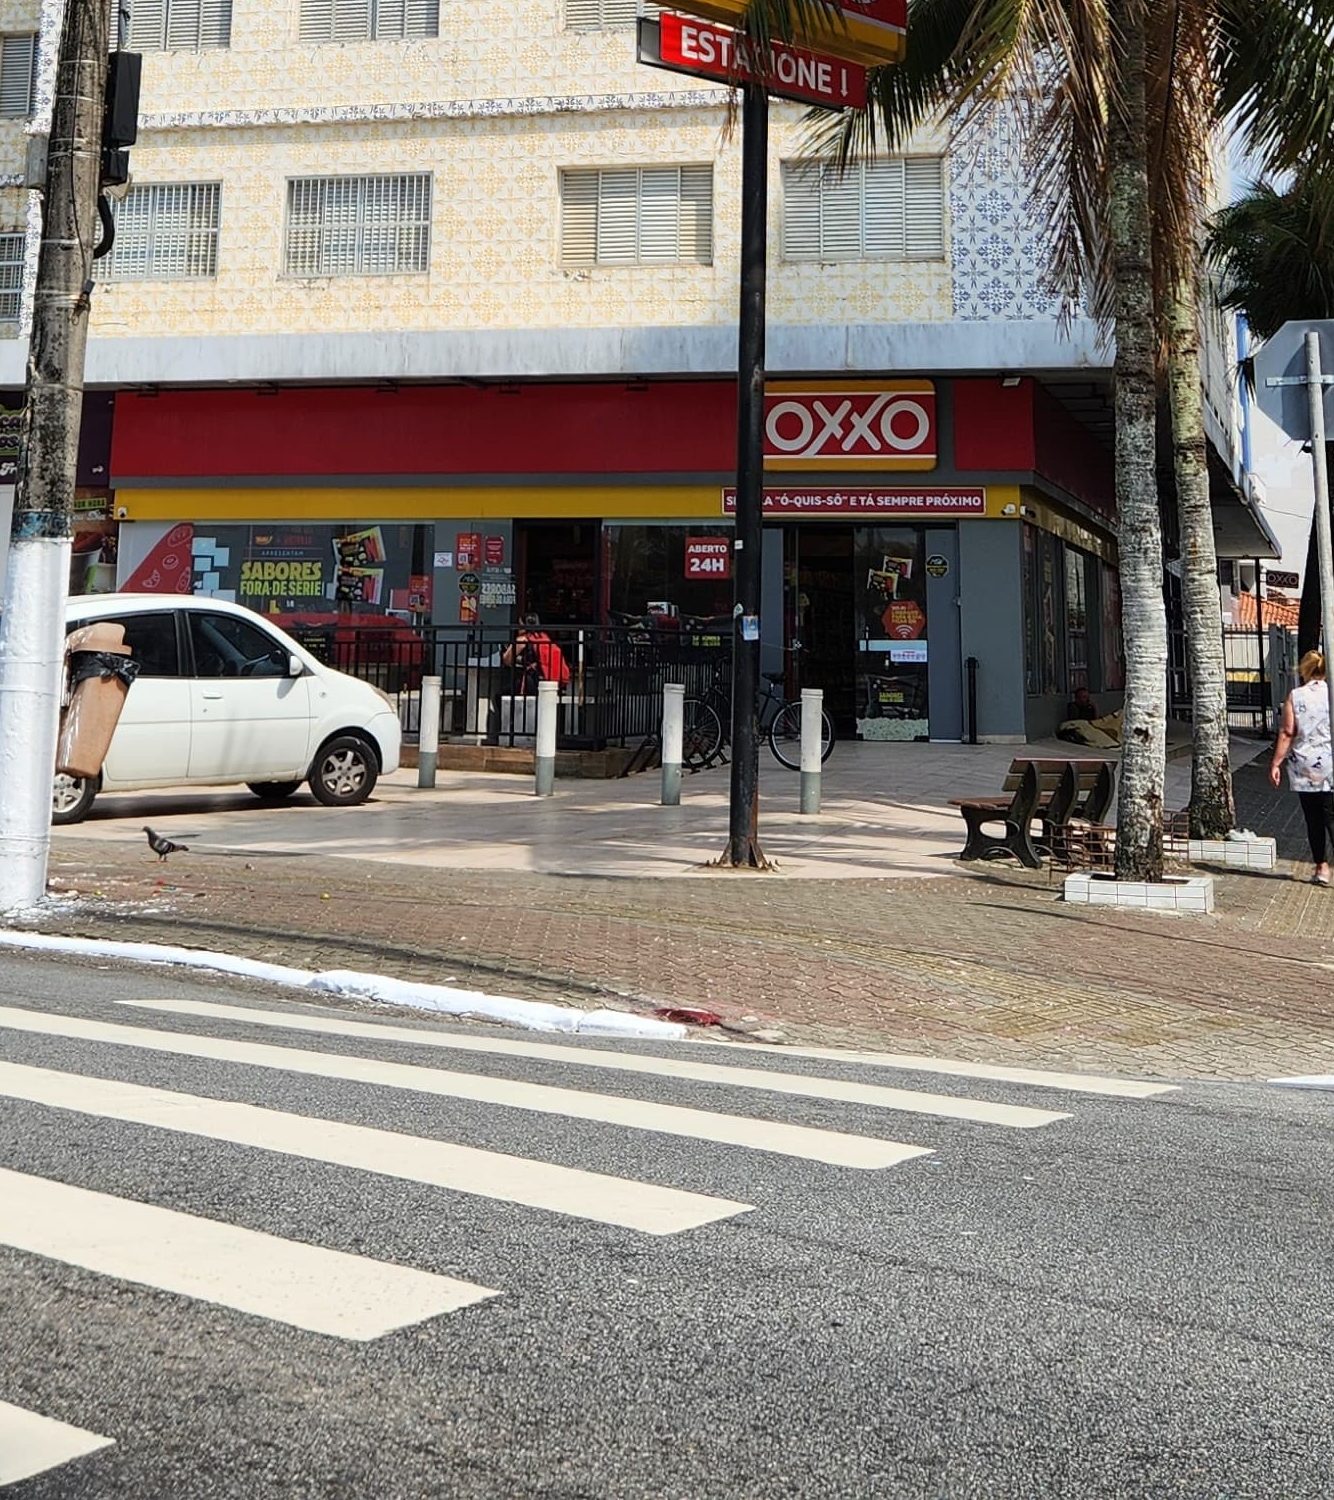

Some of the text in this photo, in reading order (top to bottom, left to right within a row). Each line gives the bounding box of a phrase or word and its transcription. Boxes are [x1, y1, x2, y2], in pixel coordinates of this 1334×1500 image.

[765, 395, 930, 456] OXXO
[850, 496, 857, 506] E
[859, 493, 875, 506] TÁ
[877, 496, 924, 506] SEMPRE
[926, 493, 982, 506] PRÓXIMO
[688, 544, 727, 553] ABERTO
[241, 561, 322, 580] SABORES
[690, 558, 724, 571] 24H
[1267, 573, 1298, 586] OXXO
[240, 581, 270, 596] FORA
